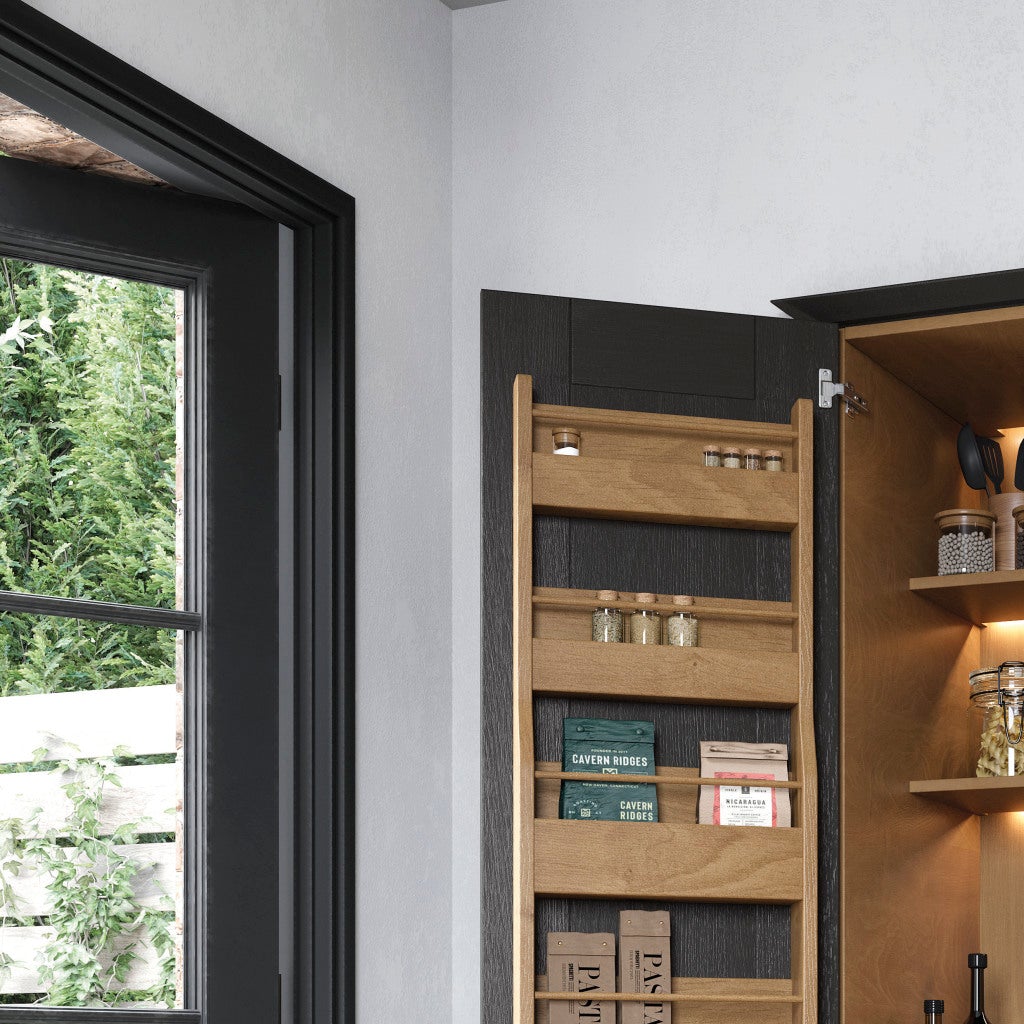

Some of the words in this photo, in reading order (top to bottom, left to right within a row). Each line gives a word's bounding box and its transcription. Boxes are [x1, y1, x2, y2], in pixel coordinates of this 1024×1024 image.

[572, 754, 610, 765] CAVERN
[613, 756, 648, 767] RIDGES
[620, 801, 653, 810] CAVERN
[620, 811, 654, 821] RIDGES
